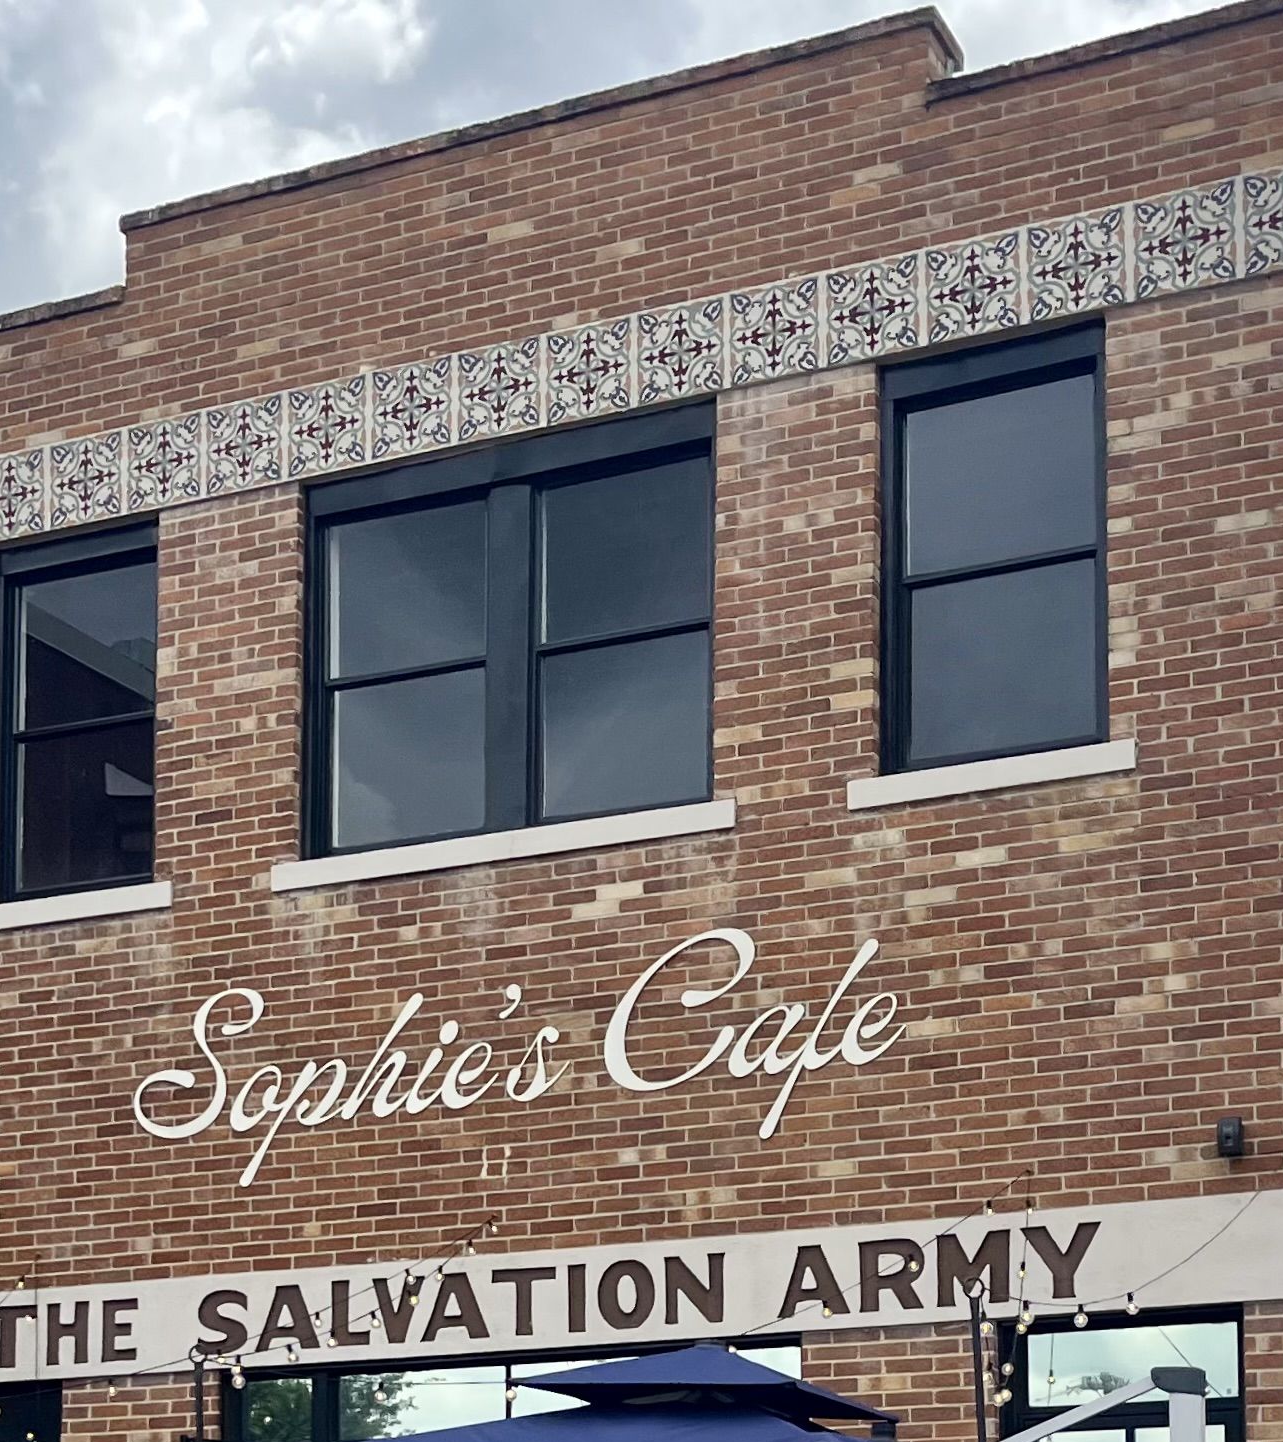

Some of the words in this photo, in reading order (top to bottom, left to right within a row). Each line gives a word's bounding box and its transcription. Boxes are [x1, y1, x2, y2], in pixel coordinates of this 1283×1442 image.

[133, 984, 571, 1187] Sophie's
[604, 928, 907, 1139] Cafe
[197, 1251, 726, 1355] SALVATION
[776, 1221, 1102, 1321] ARMY
